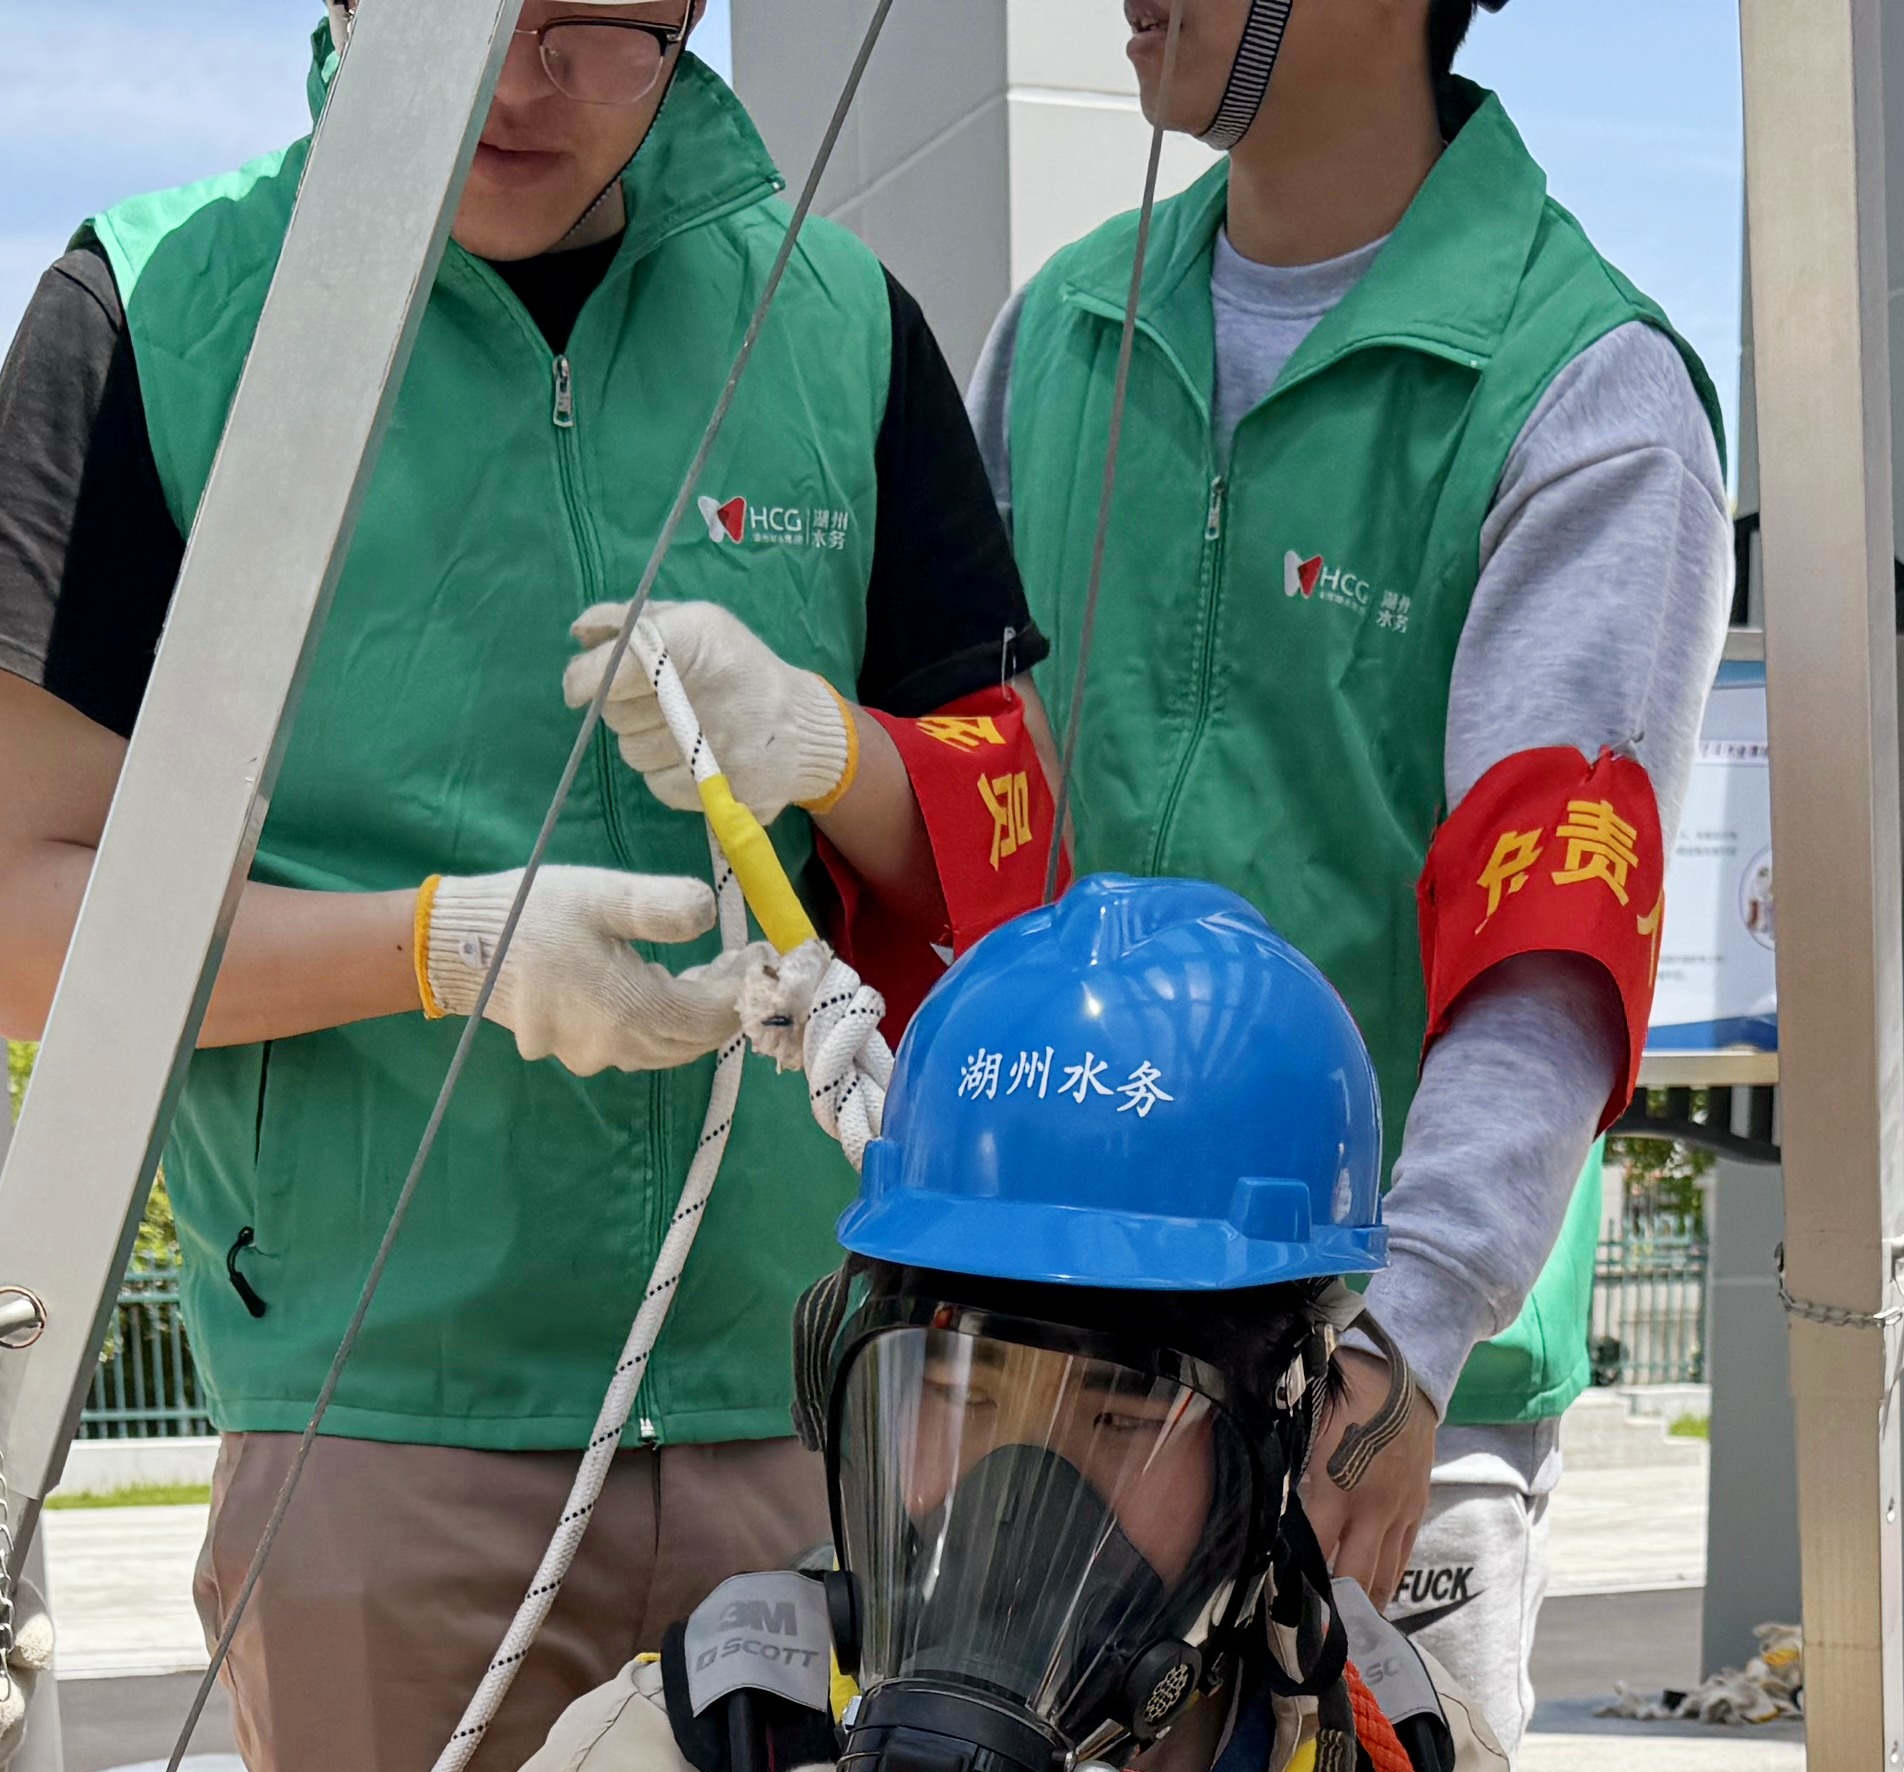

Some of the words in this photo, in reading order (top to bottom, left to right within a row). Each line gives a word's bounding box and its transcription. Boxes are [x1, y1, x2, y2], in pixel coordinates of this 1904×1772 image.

[749, 506, 802, 531] HCG
[812, 508, 849, 530] 湖州
[812, 529, 846, 550] 水务
[957, 1046, 1175, 1118] 湖州水务
[1393, 1566, 1474, 1604] FUCK
[719, 1600, 798, 1636] 3M
[720, 1637, 819, 1667] SCOTT
